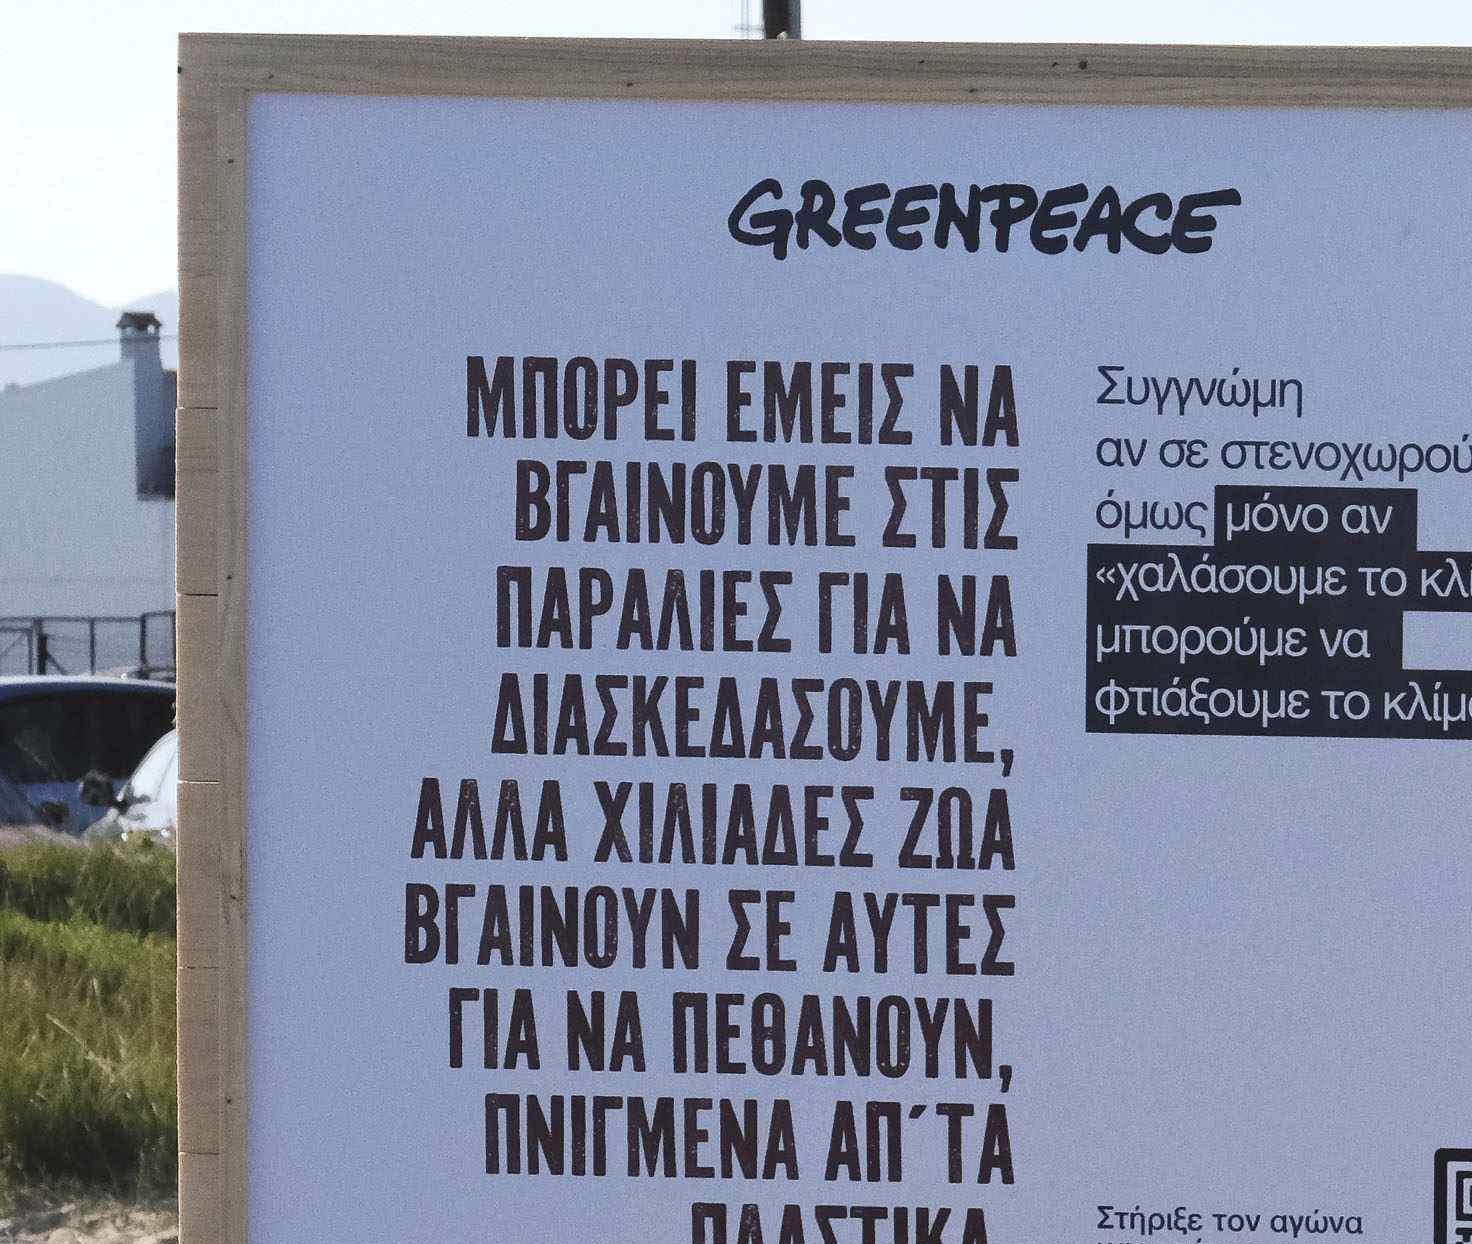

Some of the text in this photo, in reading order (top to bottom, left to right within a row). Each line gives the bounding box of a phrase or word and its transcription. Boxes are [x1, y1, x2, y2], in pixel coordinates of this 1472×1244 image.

[728, 179, 1241, 260] GREENPEACE
[467, 356, 1019, 447] ΜΠΟΡΕΙ ΕΜΕΙΣ ΝΑ
[1097, 366, 1302, 418] Συγγνώμη
[1096, 438, 1147, 467] αν
[1160, 440, 1208, 468] σε
[516, 460, 1019, 550] ΒΓΑΙΝΟΥΜΕ ΣΤΙΣ
[1096, 489, 1392, 540] όμως μόνο αν
[497, 566, 1017, 657] ΠΑΡΑΛΙΕΣ ΓΙΑ ΝΑ
[1096, 553, 1347, 604] «χαλάσουμε
[1358, 568, 1406, 596] το
[1097, 616, 1370, 665] μπορούμε να
[491, 673, 1013, 777] ΔΙΑΣΚΕΔΑΣΟΥΜΕ,
[1096, 677, 1310, 727] φτιάξουμε
[1321, 691, 1370, 719] το
[411, 778, 1015, 870] ΑΛΛΑ ΧΙΛΙΑΔΕΣ ΖΩΑ
[405, 883, 1015, 976] ΒΓΑΙΝΟΥΝ ΣΕ ΑΥΤΕΣ
[449, 988, 1012, 1093] ΓΙΑ ΝΑ ΠΕΘΑΝΟΥΝ,
[485, 1093, 799, 1180] ΠΝΙΓΜΕΝΑ
[1098, 1206, 1363, 1238] Στήριξε τον αγώνα
